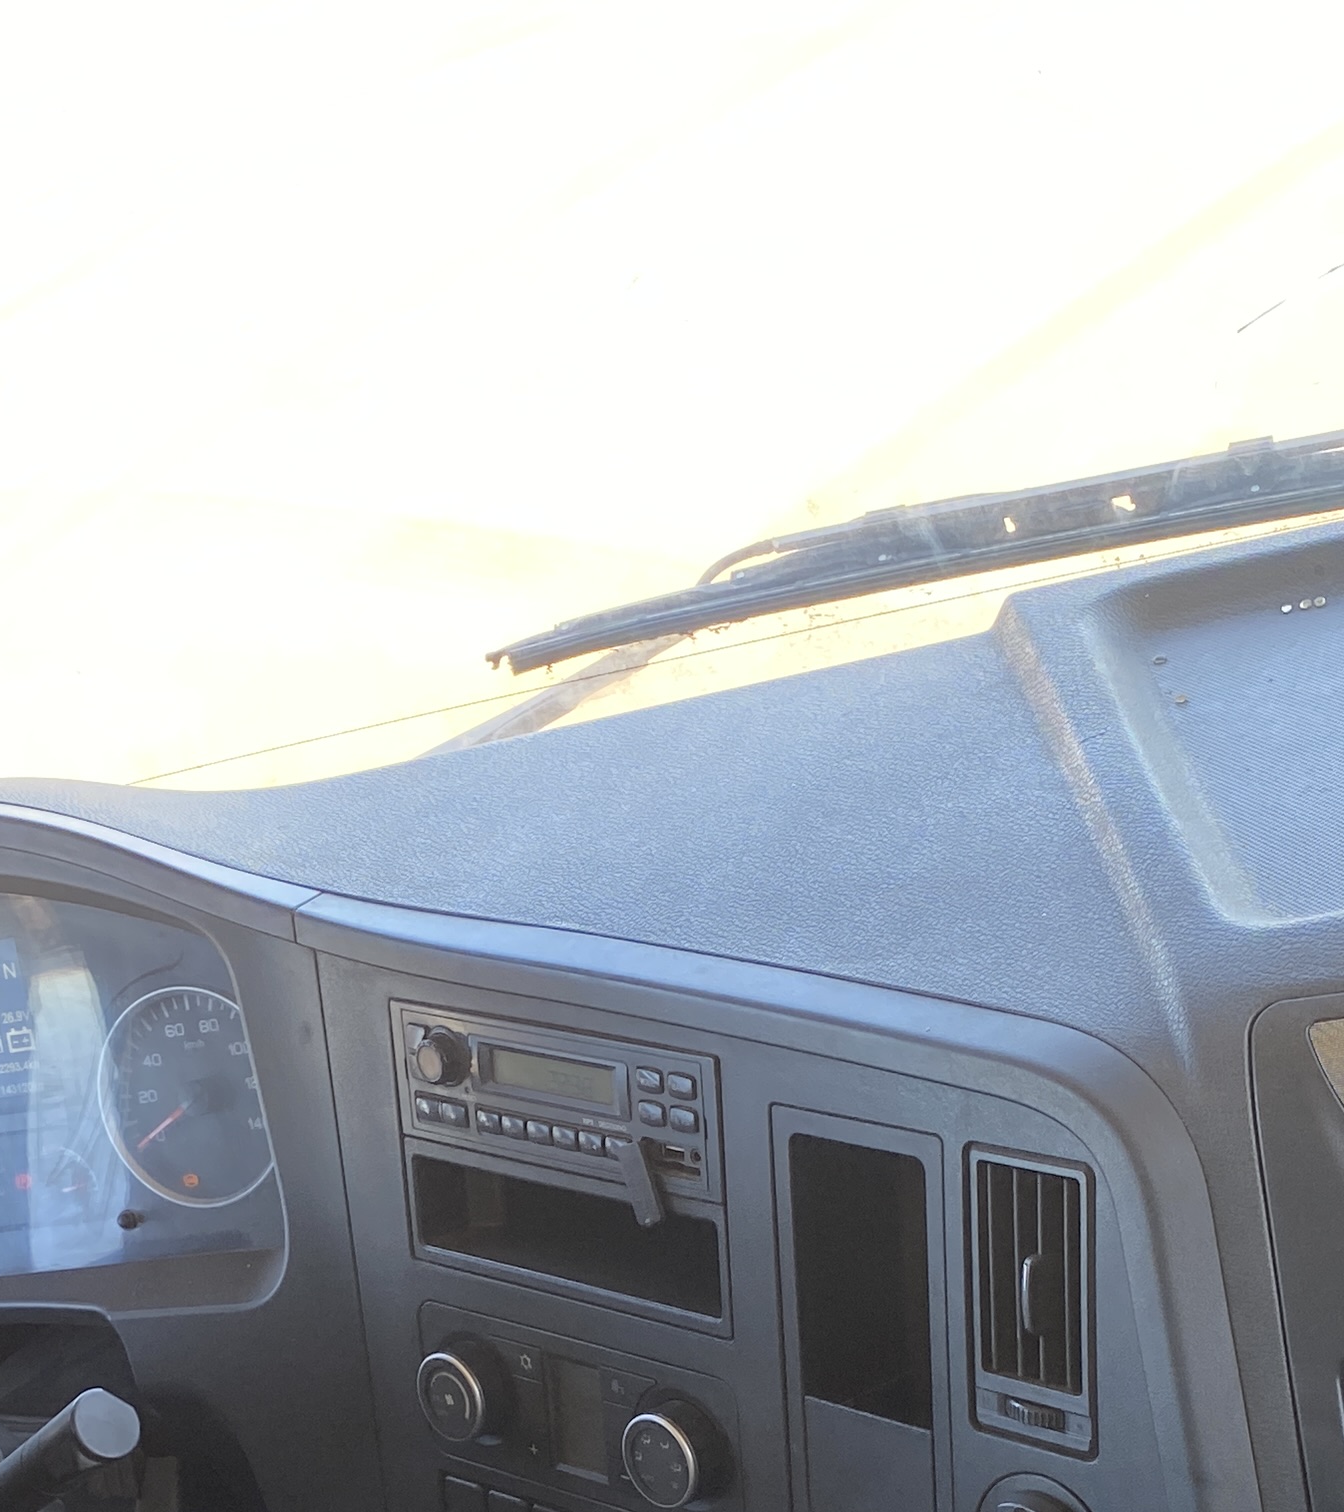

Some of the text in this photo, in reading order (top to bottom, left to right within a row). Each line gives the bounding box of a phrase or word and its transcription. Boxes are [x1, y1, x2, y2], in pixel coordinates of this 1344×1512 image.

[2, 962, 17, 980] N
[1, 1010, 29, 1024] 26.9V
[165, 1023, 184, 1037] 60
[199, 1019, 219, 1033] 80
[228, 1042, 250, 1055] 100
[143, 1053, 162, 1067] 40
[138, 1090, 158, 1104] 20
